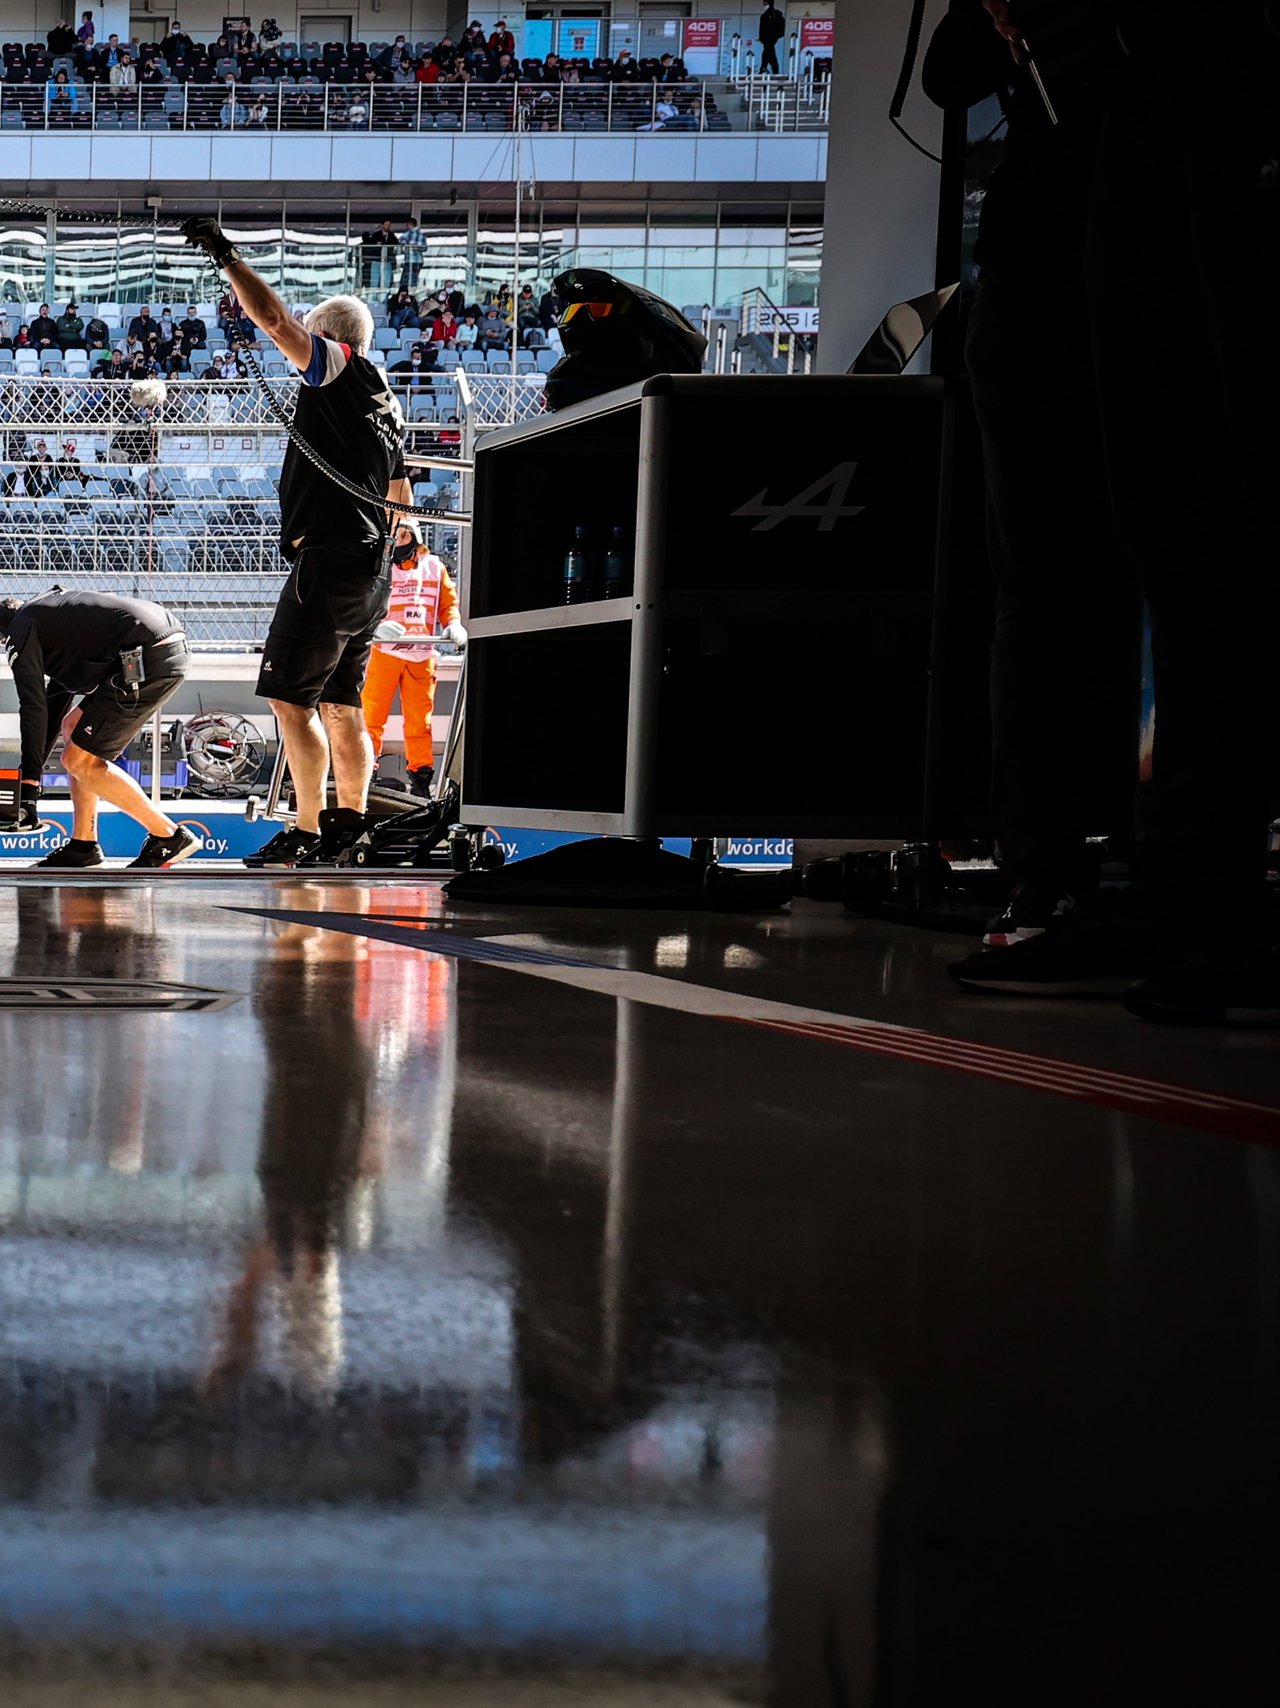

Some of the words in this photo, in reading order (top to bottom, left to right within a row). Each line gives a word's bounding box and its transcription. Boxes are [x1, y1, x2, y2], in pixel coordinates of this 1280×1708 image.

[688, 22, 716, 32] 405
[1, 832, 72, 849] workd
[727, 838, 794, 856] workd
